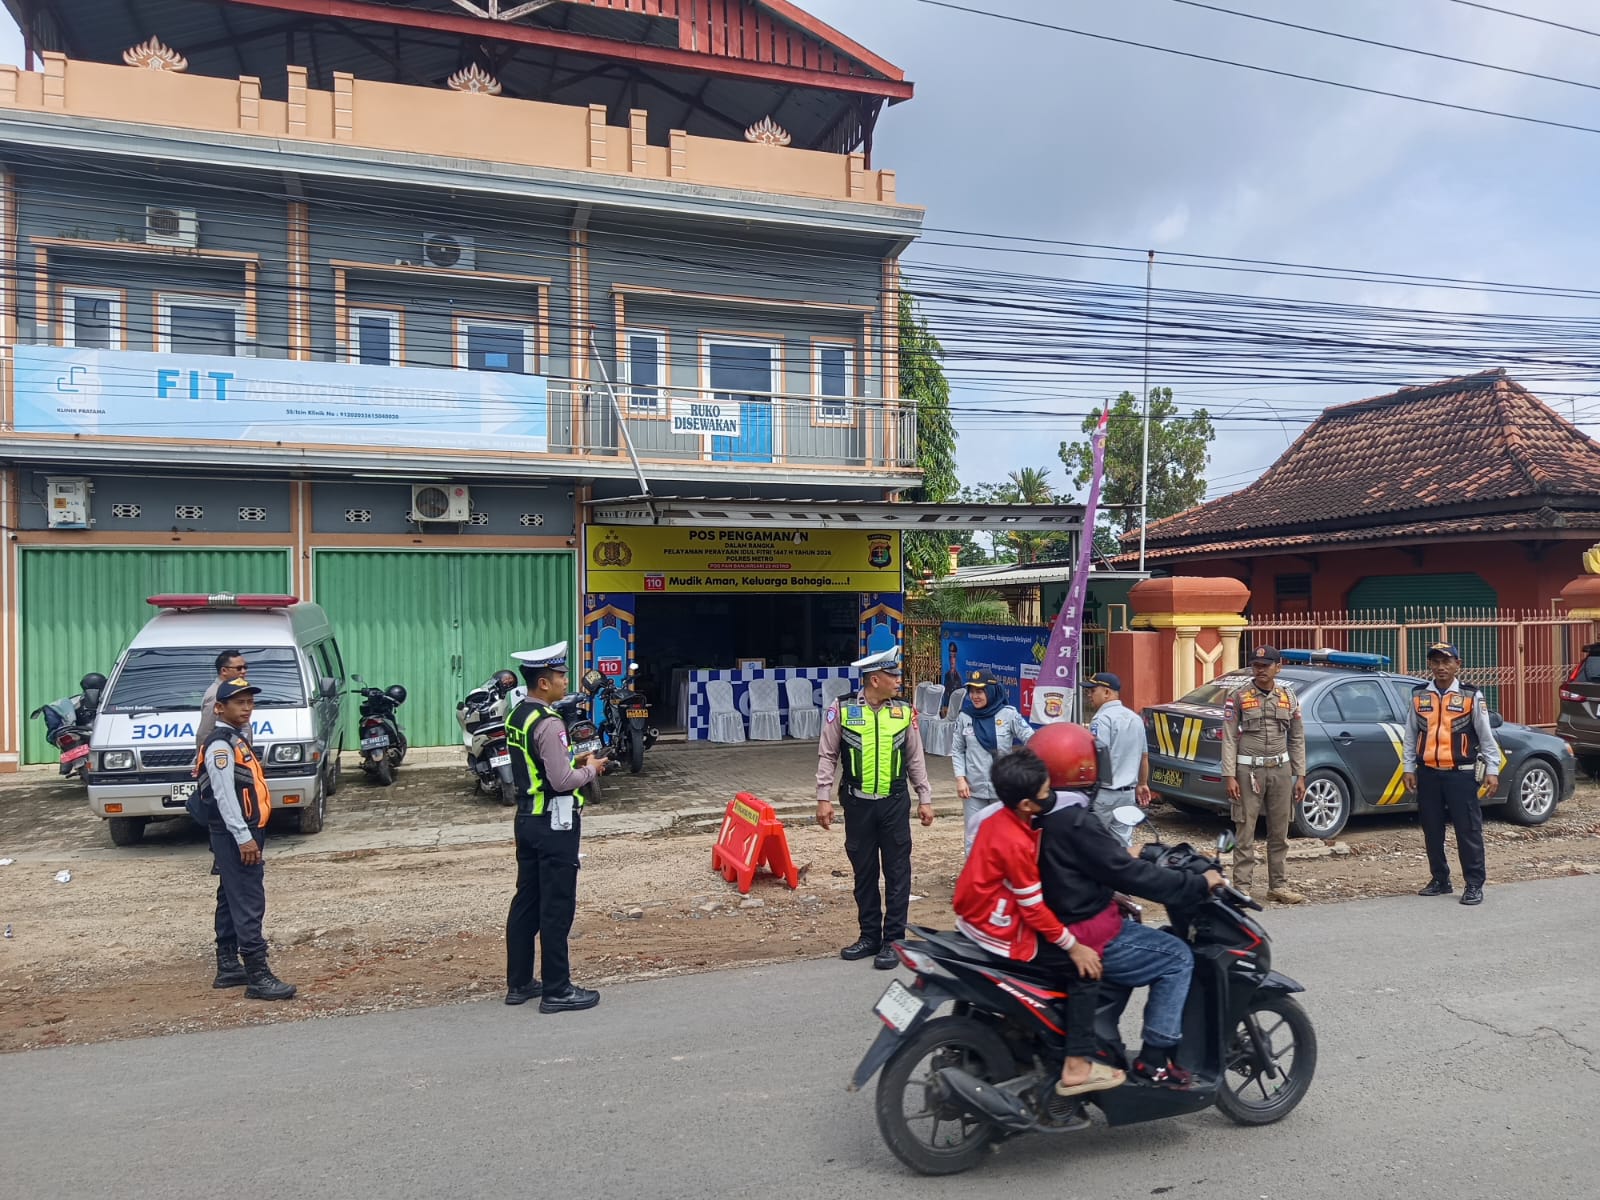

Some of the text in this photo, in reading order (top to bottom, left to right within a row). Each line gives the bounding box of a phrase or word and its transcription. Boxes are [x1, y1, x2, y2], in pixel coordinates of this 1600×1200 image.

[158, 368, 235, 401] FIT
[690, 404, 721, 418] RUKO
[674, 416, 737, 433] DISEWAKAN
[689, 530, 716, 541] POS
[646, 578, 662, 588] 110
[669, 576, 702, 586] Mudik
[705, 577, 738, 588] Aman,
[742, 577, 788, 588] Keluarga
[600, 662, 618, 672] 110
